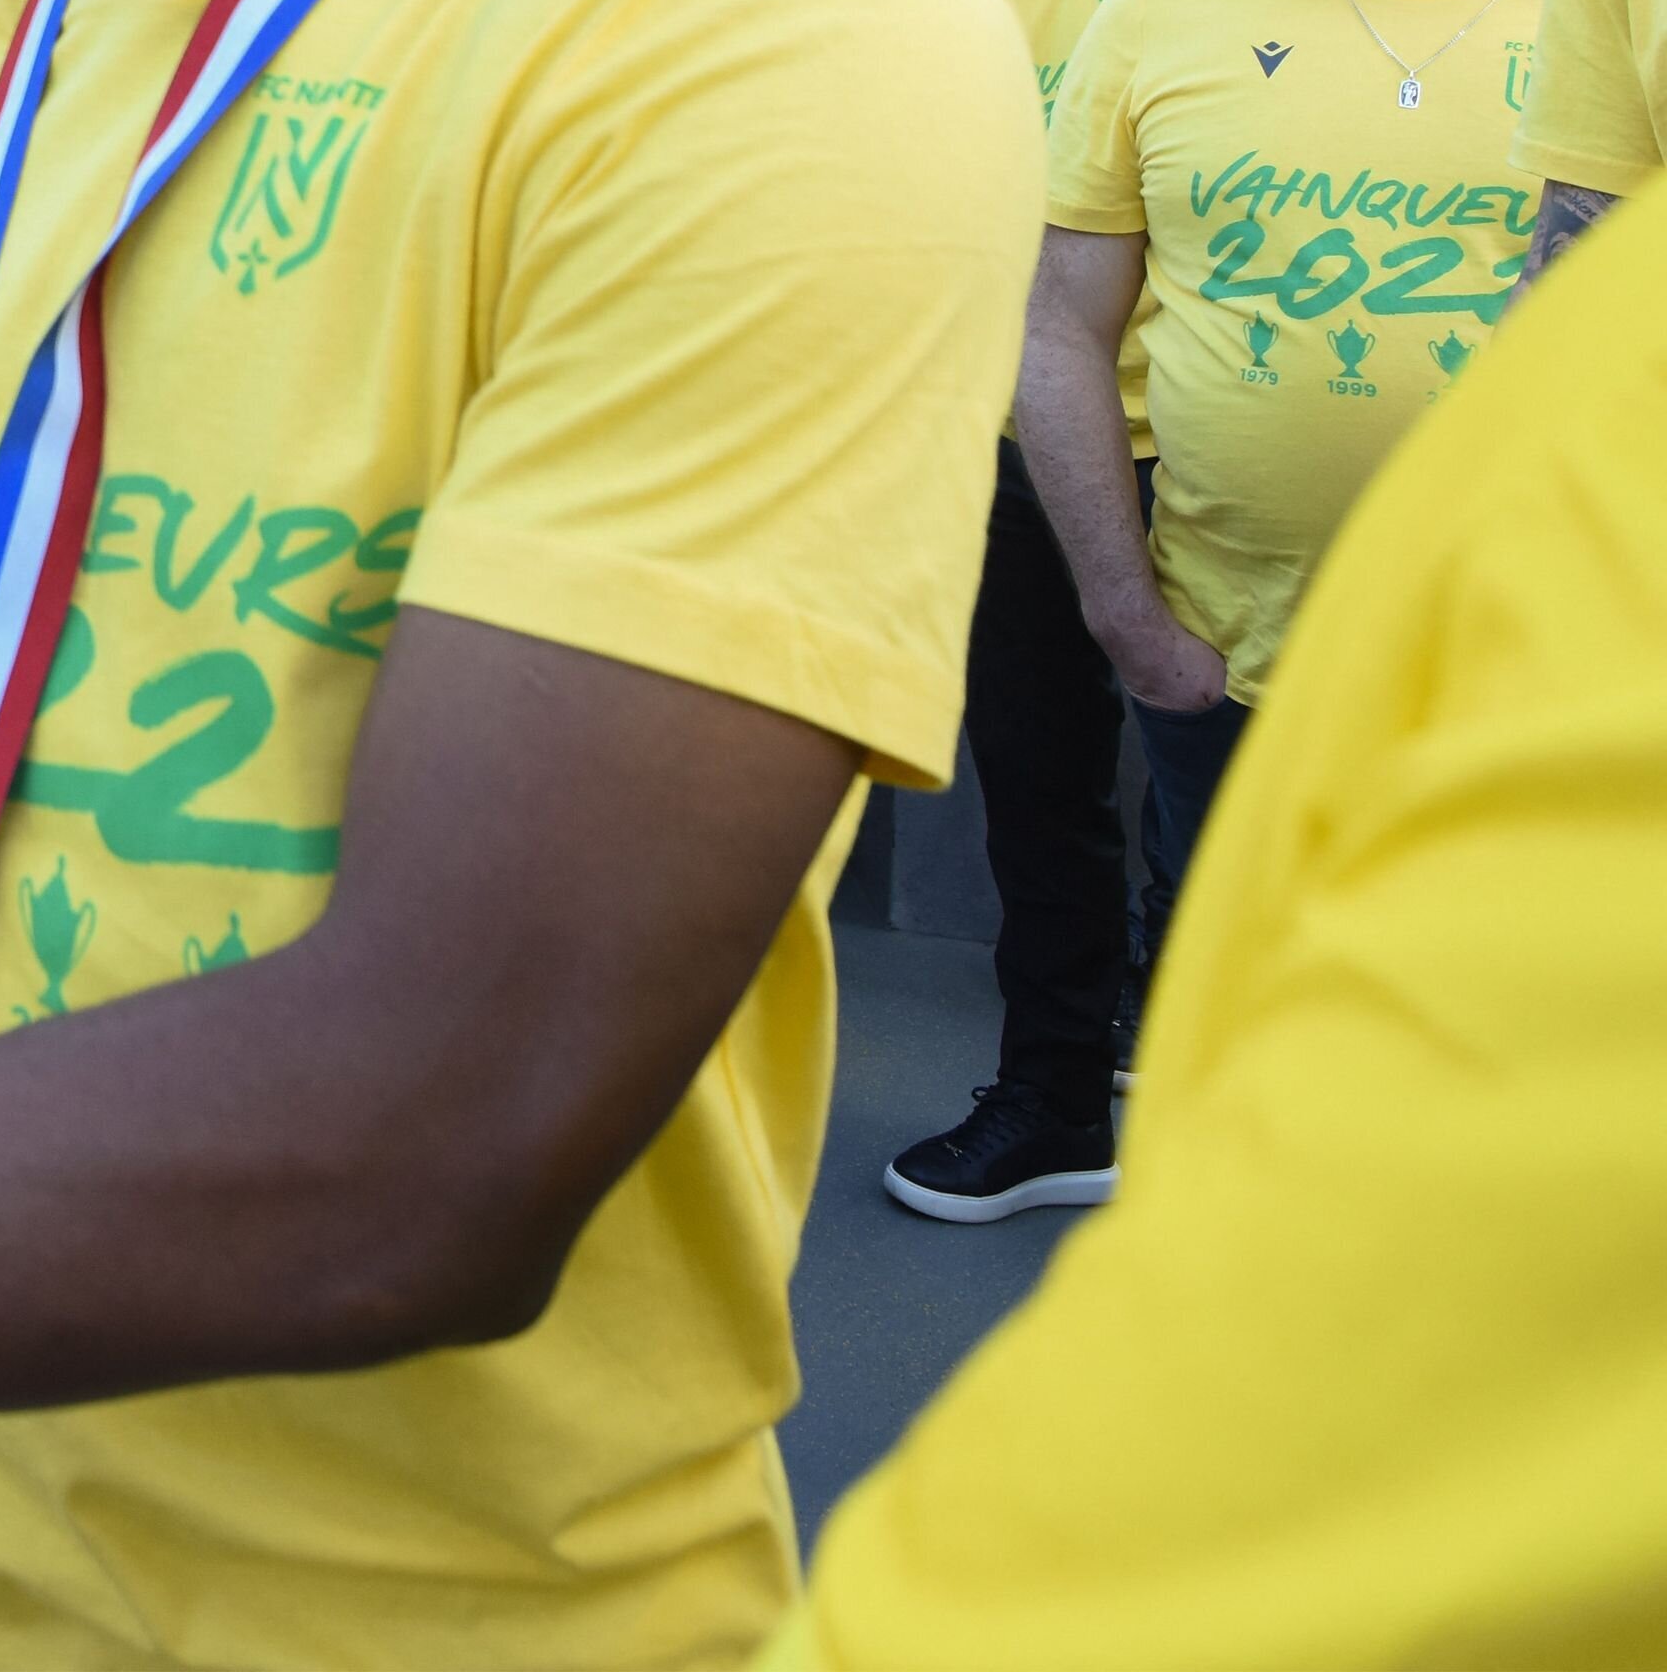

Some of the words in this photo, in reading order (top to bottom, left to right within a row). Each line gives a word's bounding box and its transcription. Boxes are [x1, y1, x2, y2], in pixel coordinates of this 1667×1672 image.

[1505, 41, 1523, 52] FC
[253, 73, 291, 101] FC
[1238, 367, 1279, 386] 1979
[1327, 378, 1377, 398] 1999
